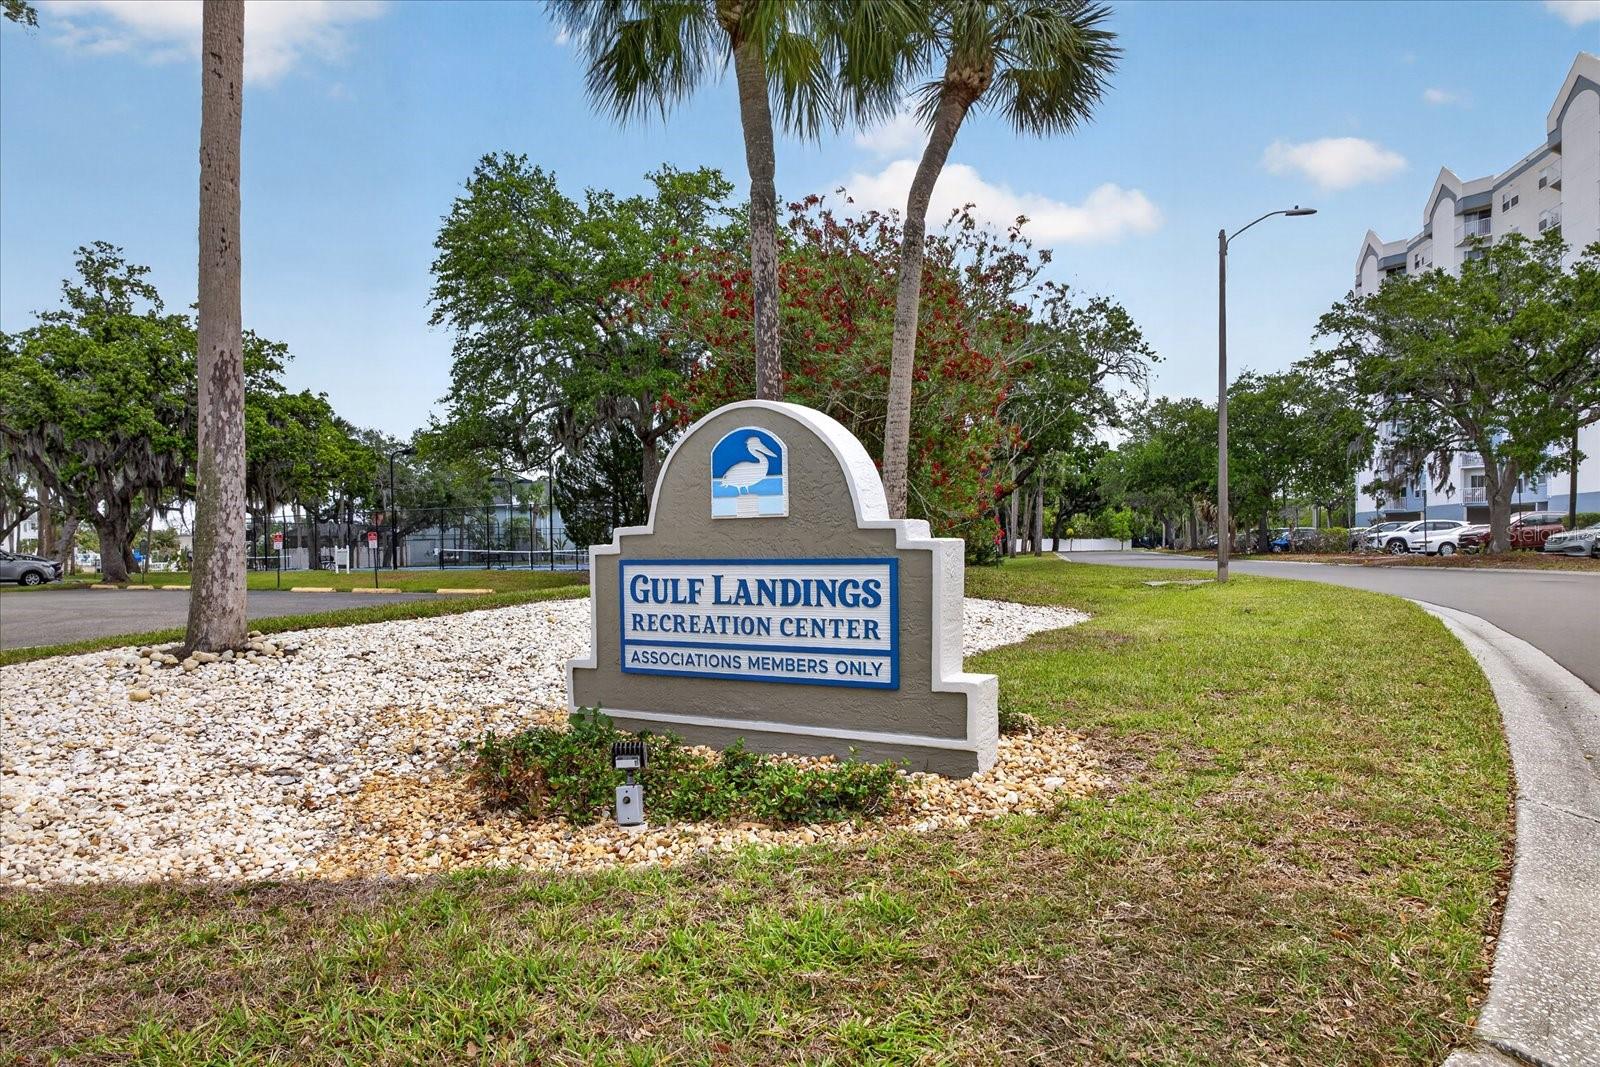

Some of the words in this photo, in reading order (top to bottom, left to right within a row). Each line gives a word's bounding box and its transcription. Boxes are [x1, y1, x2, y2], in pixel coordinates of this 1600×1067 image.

[629, 573, 705, 605] GULF
[711, 574, 883, 608] LANDINGS
[631, 613, 773, 637] RECREATION
[779, 617, 882, 641] CENTER
[630, 649, 742, 670] ASSOCIATIONS
[747, 655, 829, 674] MEMBERS
[835, 660, 884, 678] ONLY
